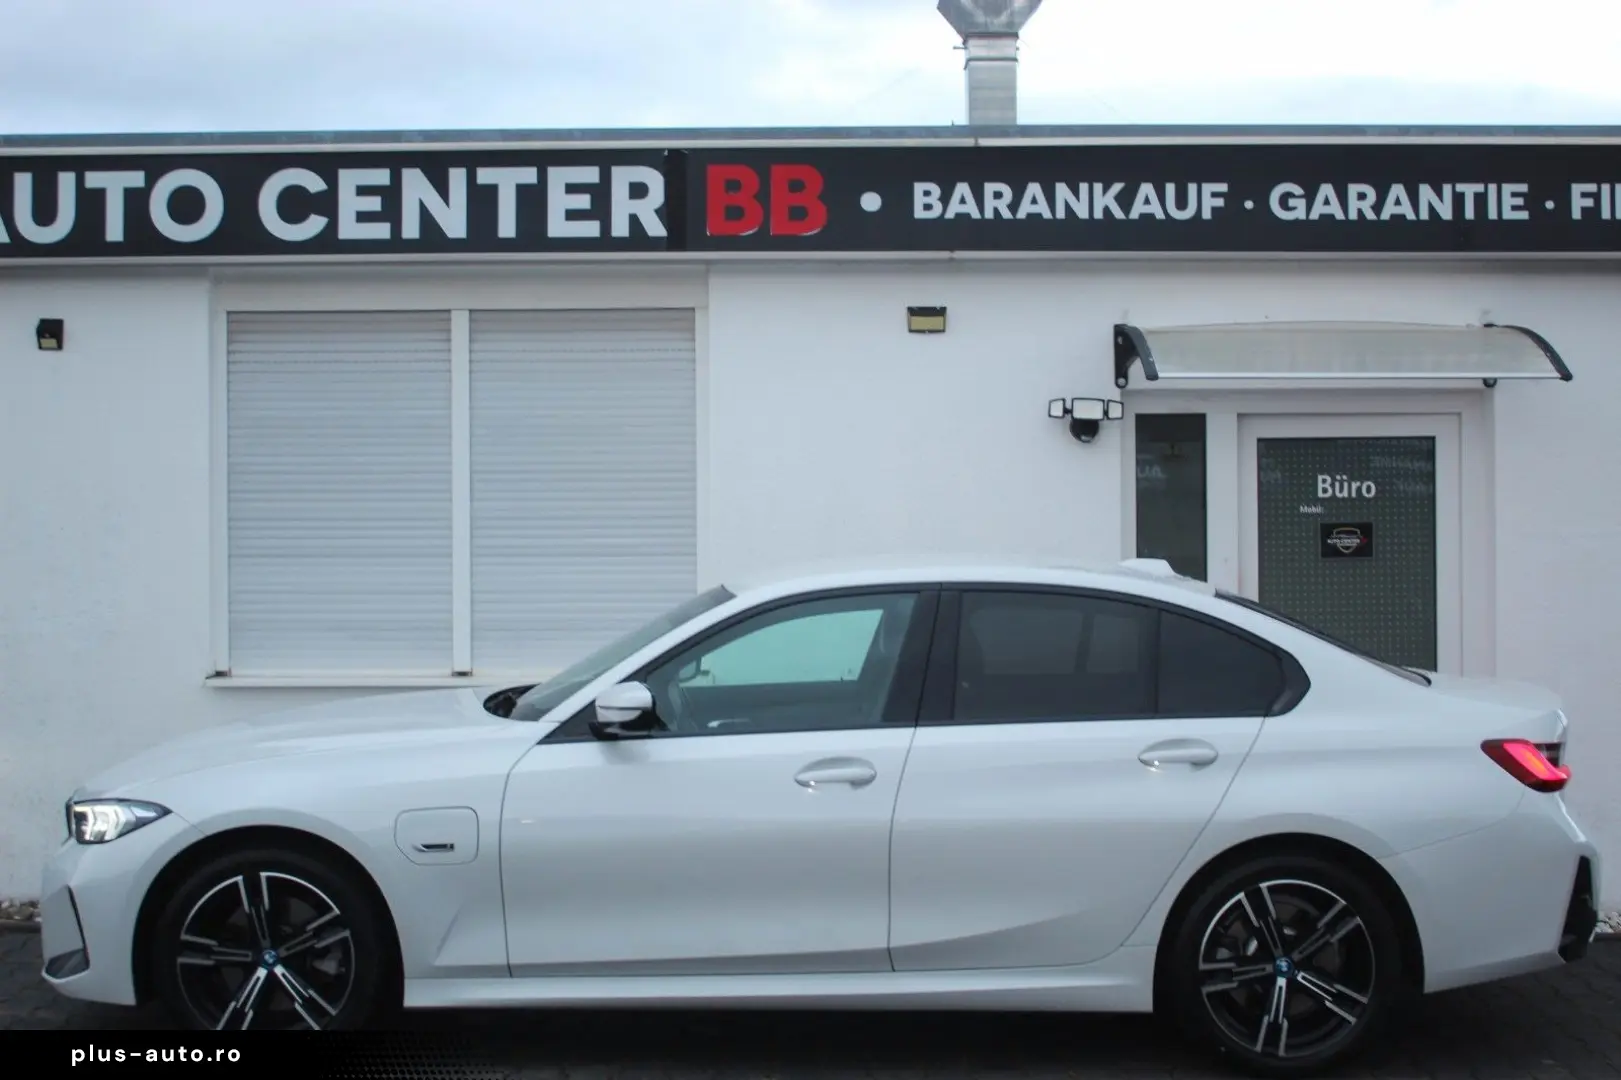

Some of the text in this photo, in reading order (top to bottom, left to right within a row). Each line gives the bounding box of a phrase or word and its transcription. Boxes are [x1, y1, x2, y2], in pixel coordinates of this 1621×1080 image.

[0, 164, 1621, 244] UTO CENTER BB BARANKAUF GARANTIE FI
[1317, 474, 1377, 499] Büro
